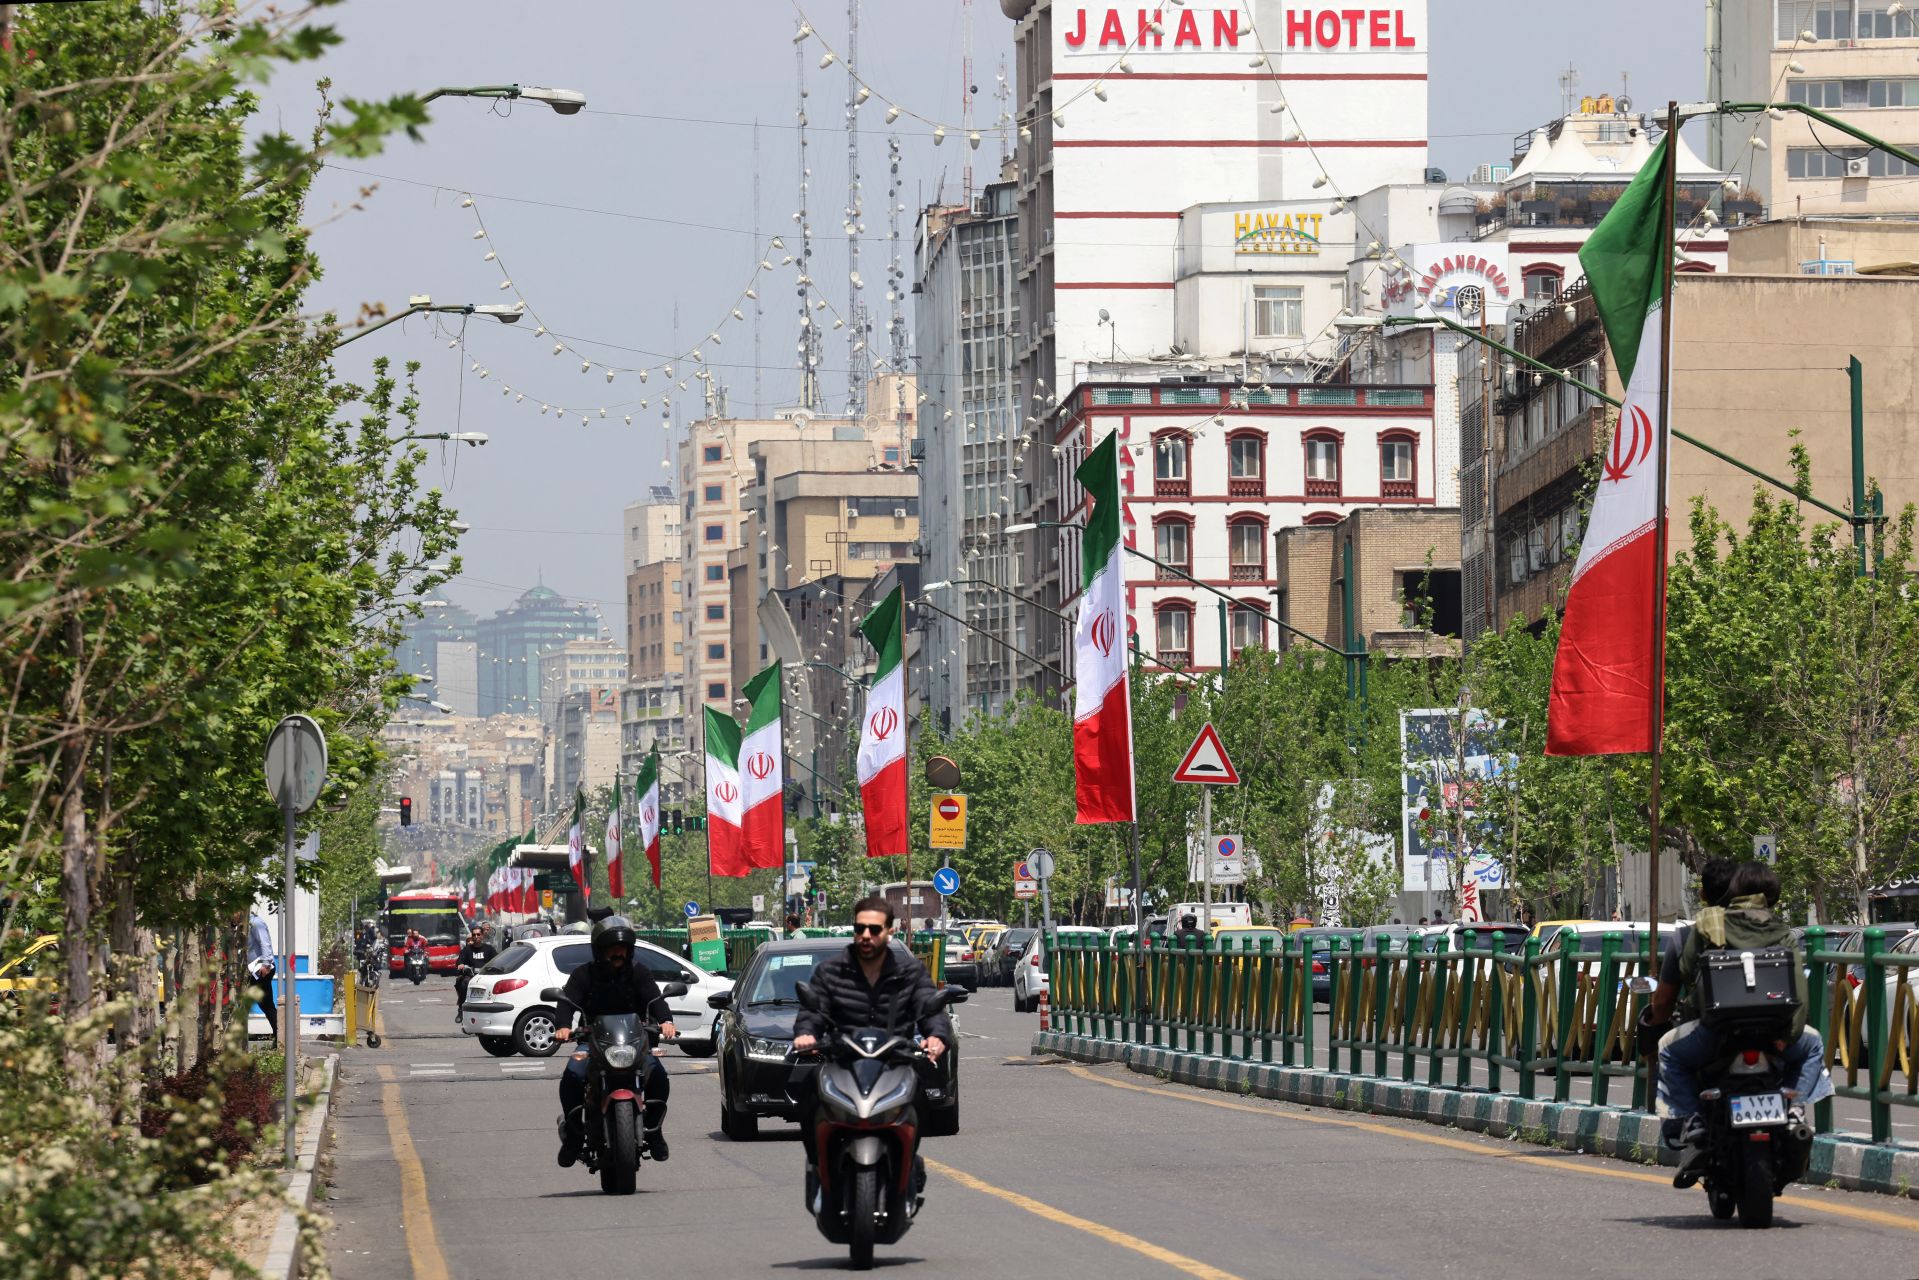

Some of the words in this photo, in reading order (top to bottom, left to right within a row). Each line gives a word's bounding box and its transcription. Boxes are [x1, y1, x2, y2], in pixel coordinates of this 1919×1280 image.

[1065, 8, 1238, 48] JAHAN
[1286, 9, 1415, 48] HOTEL
[1234, 212, 1323, 240] HAYATT
[1242, 242, 1313, 252] LOUNGE
